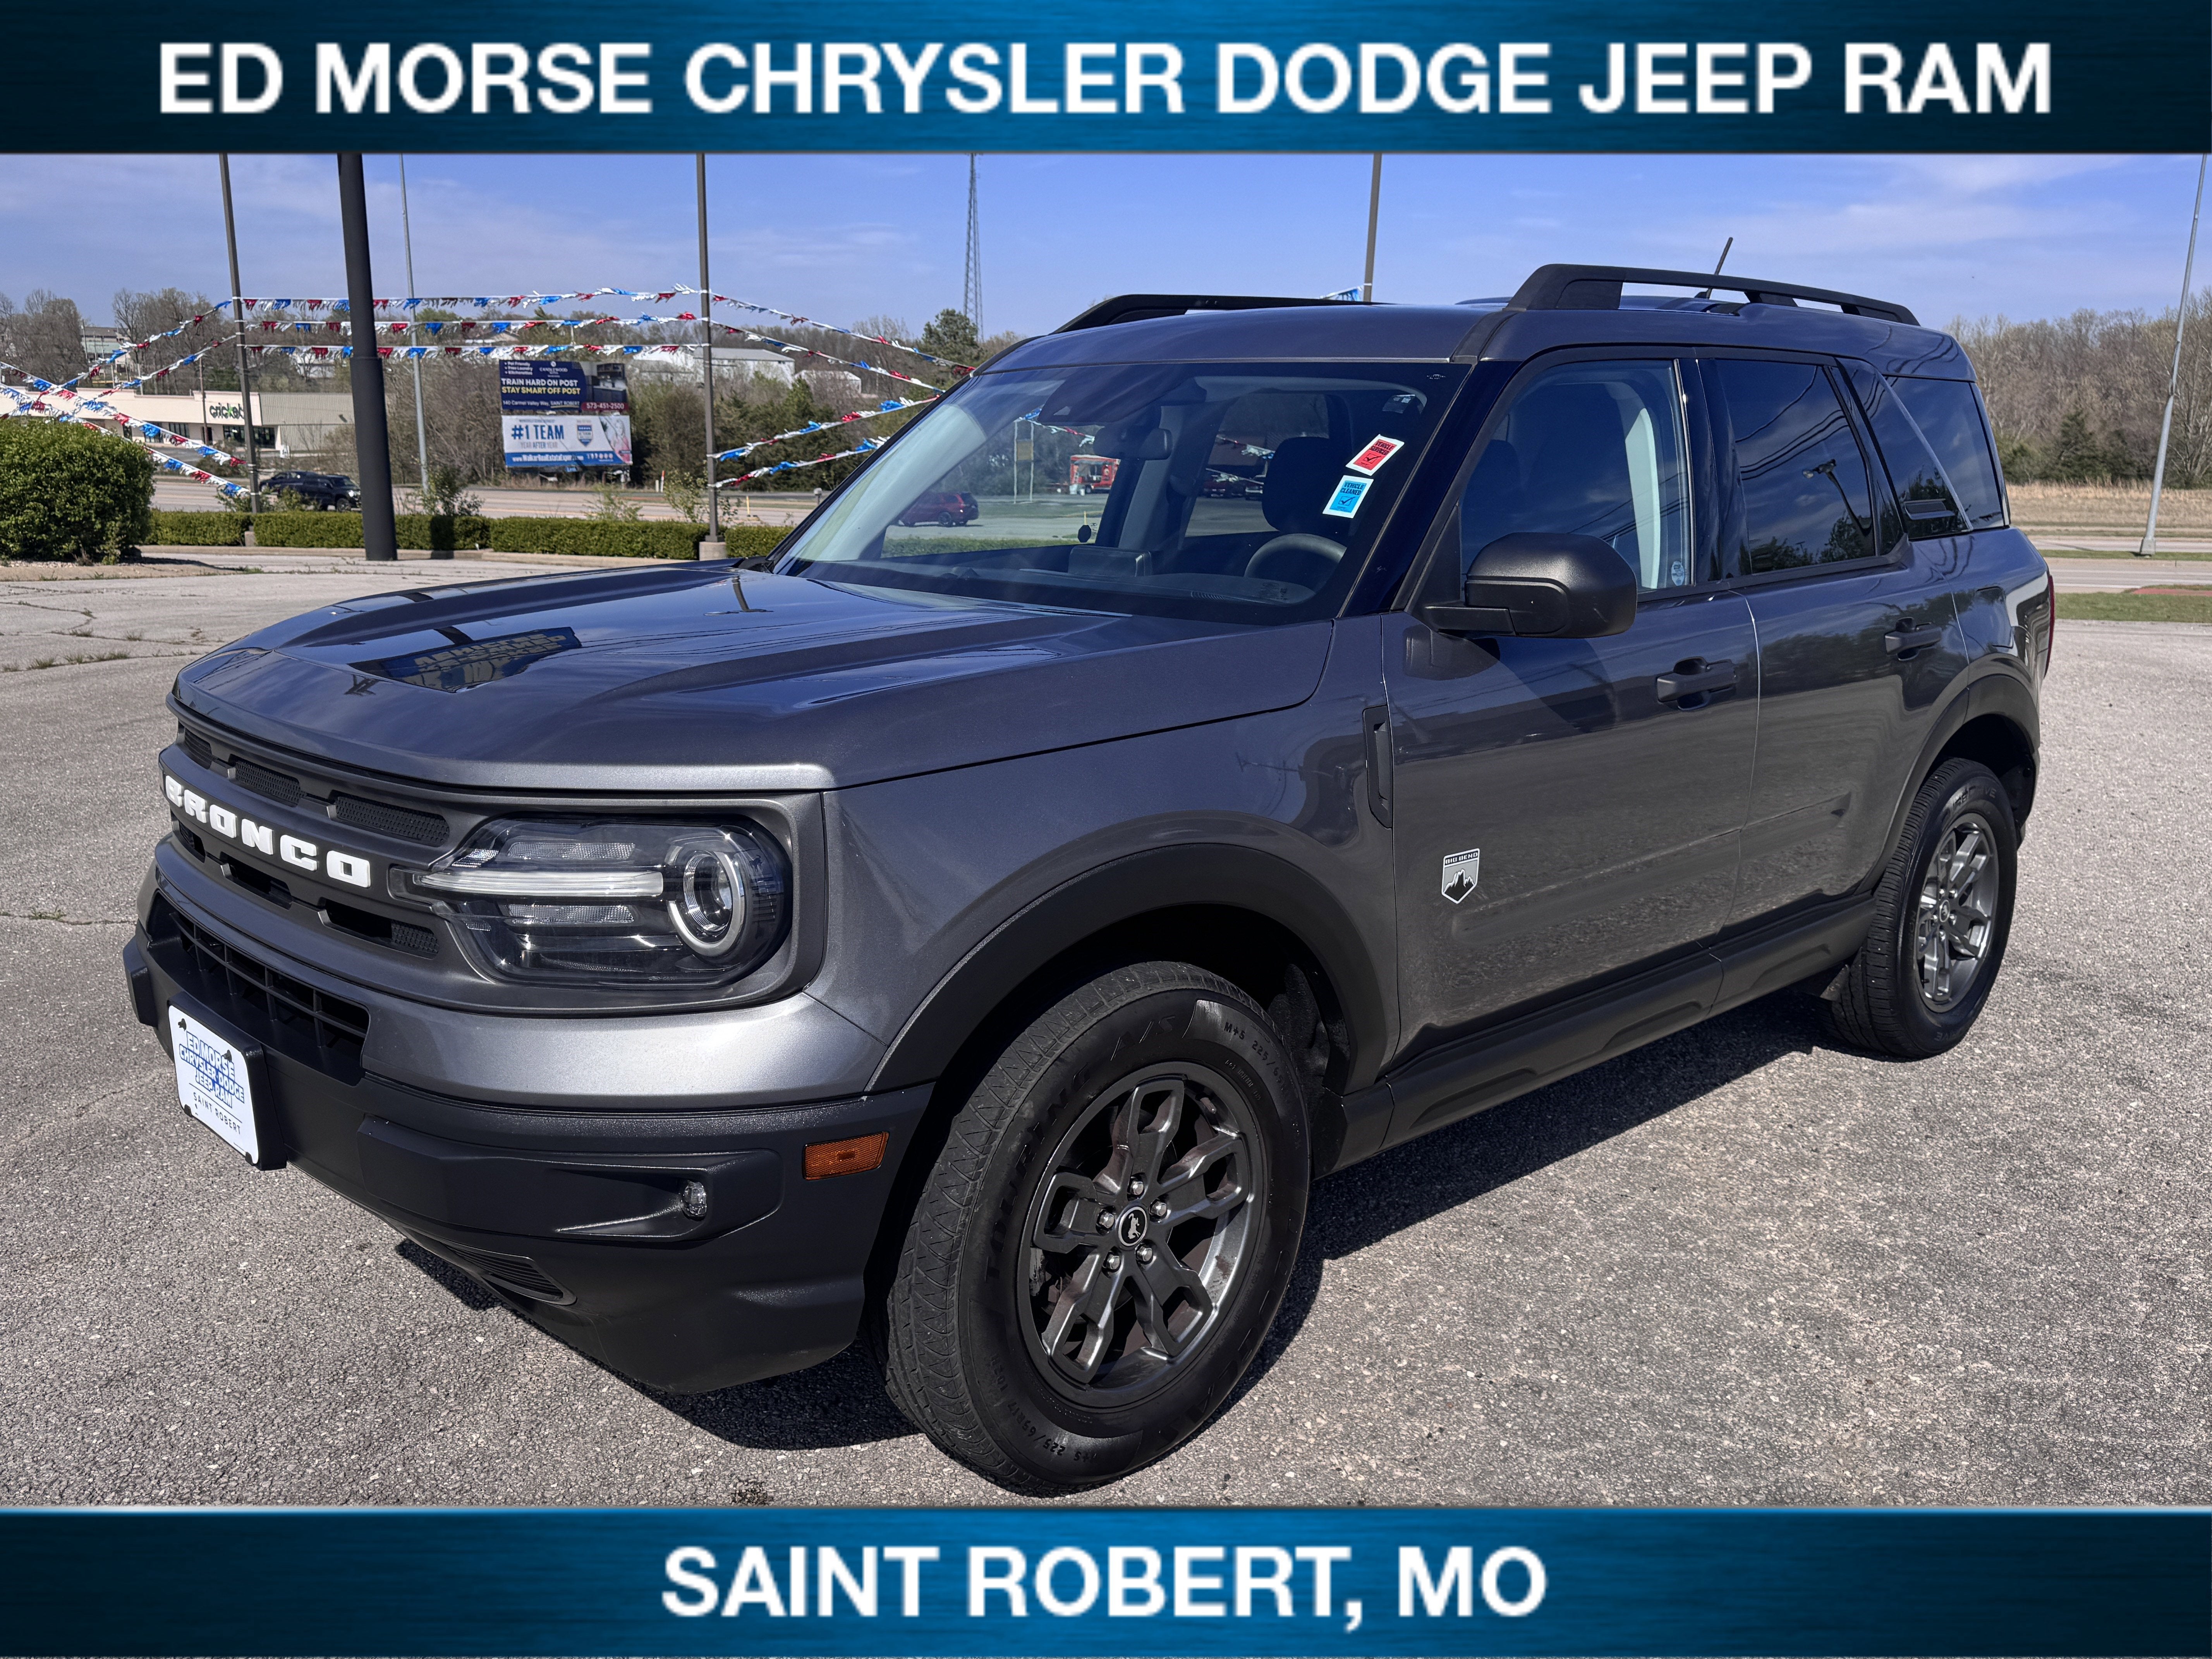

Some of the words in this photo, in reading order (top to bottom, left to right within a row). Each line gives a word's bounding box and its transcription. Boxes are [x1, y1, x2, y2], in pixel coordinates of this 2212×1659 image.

[512, 425, 529, 440] #1
[534, 425, 564, 440] TEAM
[1340, 488, 1362, 496] CLEANED
[165, 775, 372, 888] BRONCO
[1458, 852, 1478, 861] BEND
[179, 1043, 217, 1083] CHRYSLER
[218, 1071, 244, 1104] DODGE
[186, 1030, 200, 1056] ED
[199, 1039, 235, 1080] MORSE
[195, 1070, 213, 1092] JEEP
[214, 1083, 232, 1108] RAM
[193, 1092, 212, 1112] SAINT
[215, 1108, 241, 1135] ROBERT
